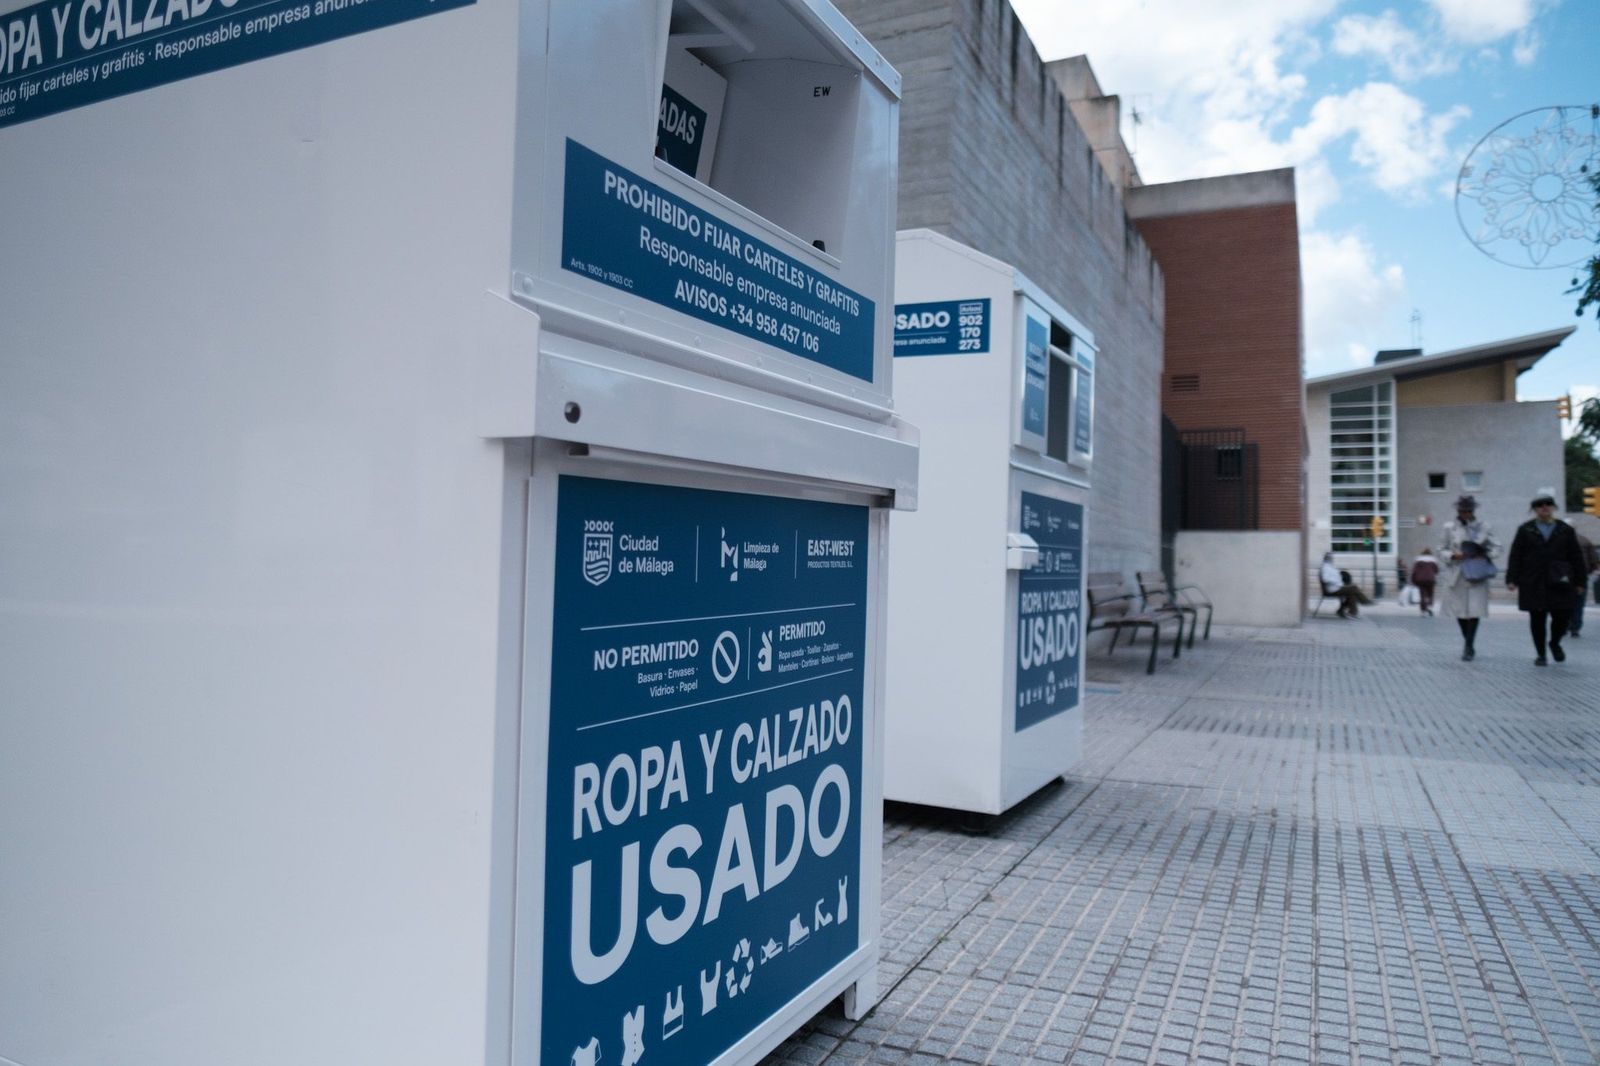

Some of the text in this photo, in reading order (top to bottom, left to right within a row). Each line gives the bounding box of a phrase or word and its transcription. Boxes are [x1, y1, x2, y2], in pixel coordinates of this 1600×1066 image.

[52, 2, 72, 59] Y
[20, 80, 40, 101] fijar
[43, 67, 89, 92] carteles
[92, 64, 99, 82] y
[101, 48, 145, 80] grafitis
[155, 22, 241, 60] Responsable
[245, 4, 310, 35] empresa
[813, 86, 831, 98] EW
[604, 170, 859, 317] PROHIBIDO FIJAR CARTELES Y GRAFITIS
[588, 264, 603, 278] 1902
[604, 272, 608, 280] y
[624, 278, 634, 288] CC
[640, 225, 841, 335] Responsable empresa anunciada
[675, 279, 819, 353] AVISOS +34 958 437 106
[893, 311, 951, 331] SADO
[958, 314, 983, 327] 902
[960, 326, 981, 338] 170
[958, 338, 981, 351] 273
[619, 534, 659, 552] Ciudad
[743, 541, 780, 554] Limpieza de
[618, 557, 674, 577] de Málaga
[743, 557, 768, 572] Málaga
[1021, 590, 1079, 614] ROPA Y CALZADO
[780, 620, 826, 641] PERMITIDO
[1020, 612, 1079, 671] USADO
[593, 638, 699, 672] NO PERMITIDO
[638, 667, 695, 684] Basura Envases
[650, 679, 698, 698] Vidrios Papel
[572, 694, 852, 841] ROPA Y CALZADO
[570, 764, 850, 985] USADO
